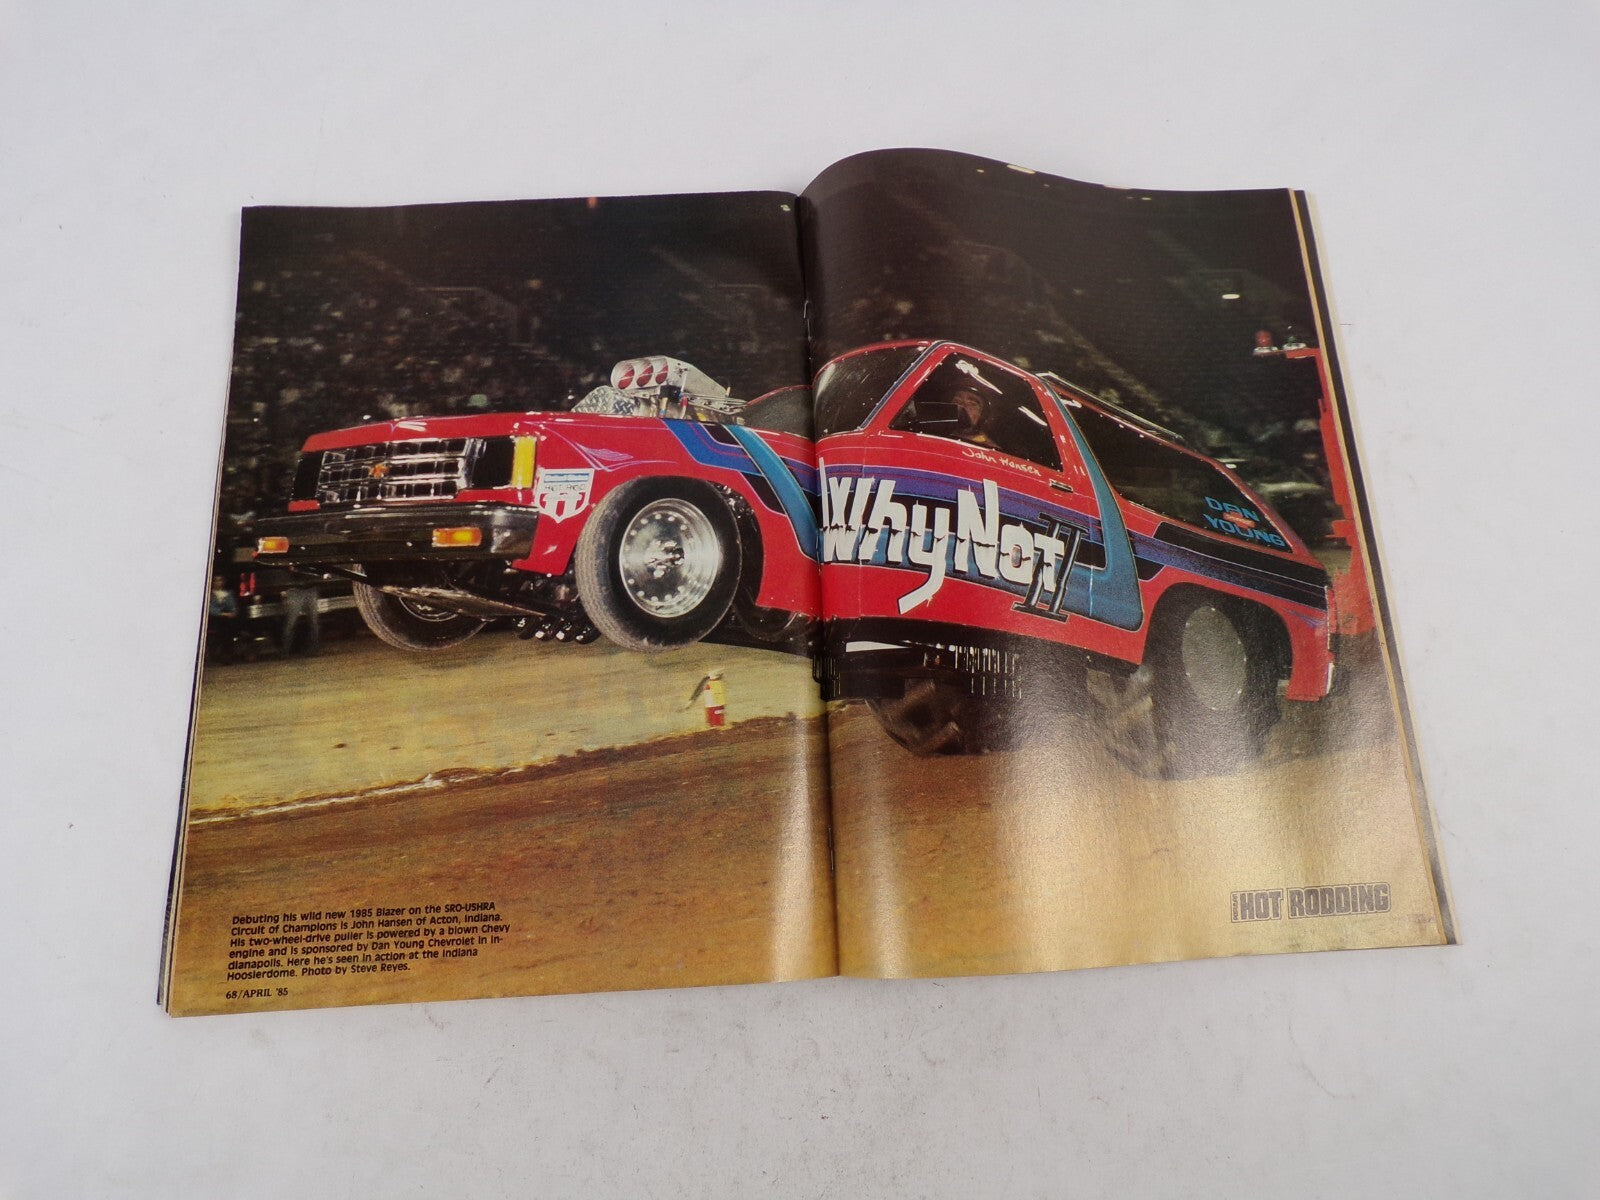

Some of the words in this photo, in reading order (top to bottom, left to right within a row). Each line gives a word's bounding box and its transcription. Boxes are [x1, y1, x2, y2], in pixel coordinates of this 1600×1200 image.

[962, 448, 997, 463] John
[999, 456, 1042, 477] Hansen
[1204, 496, 1260, 522] DAN
[1202, 514, 1286, 546] YOUNG
[232, 914, 280, 924] Debuting
[283, 912, 297, 920] his
[300, 911, 322, 920] wild
[325, 910, 346, 920] new
[350, 908, 372, 918] 1985
[376, 907, 405, 916] Blazer
[408, 907, 422, 915] on
[425, 904, 442, 914] the
[444, 902, 496, 912] SRO-USHRA
[1240, 890, 1282, 920] HOT
[1289, 883, 1390, 917] RODDING
[230, 938, 246, 948] His
[249, 934, 330, 946] two-wheel-drive
[334, 931, 364, 942] puller
[366, 930, 374, 939] is
[376, 928, 420, 940] powered
[424, 927, 436, 937] by
[439, 928, 445, 936] a
[448, 925, 478, 935] blown
[481, 924, 510, 934] Chevy
[231, 926, 265, 936] Circuit
[268, 925, 280, 934] of
[282, 922, 337, 933] Champions
[340, 921, 348, 930] is
[351, 920, 374, 930] John
[378, 917, 412, 928] Hansen
[416, 916, 426, 926] of
[430, 915, 461, 925] Acton,
[464, 913, 503, 922] Indiana.
[228, 948, 264, 959] engine
[268, 946, 287, 956] and
[290, 946, 298, 955] is
[302, 943, 354, 955] sponsored
[356, 942, 368, 952] by
[372, 941, 390, 950] Dan
[394, 940, 424, 950] Young
[428, 936, 475, 948] Chevrolet
[478, 935, 488, 944] in
[228, 958, 284, 970] dianapolis.
[287, 957, 310, 966] Here
[314, 956, 334, 965] he's
[336, 954, 358, 964] seen
[362, 954, 372, 962] in
[375, 951, 406, 962] action
[408, 950, 419, 959] at
[422, 950, 439, 958] the
[442, 948, 478, 958] Indiana
[227, 968, 298, 981] Hoosierdome.
[301, 966, 332, 976] Photo
[335, 965, 347, 975] by
[350, 964, 378, 974] Steve
[380, 962, 410, 972] Reyes.
[226, 988, 272, 1000] 68/APRIL
[276, 987, 288, 997] '85
